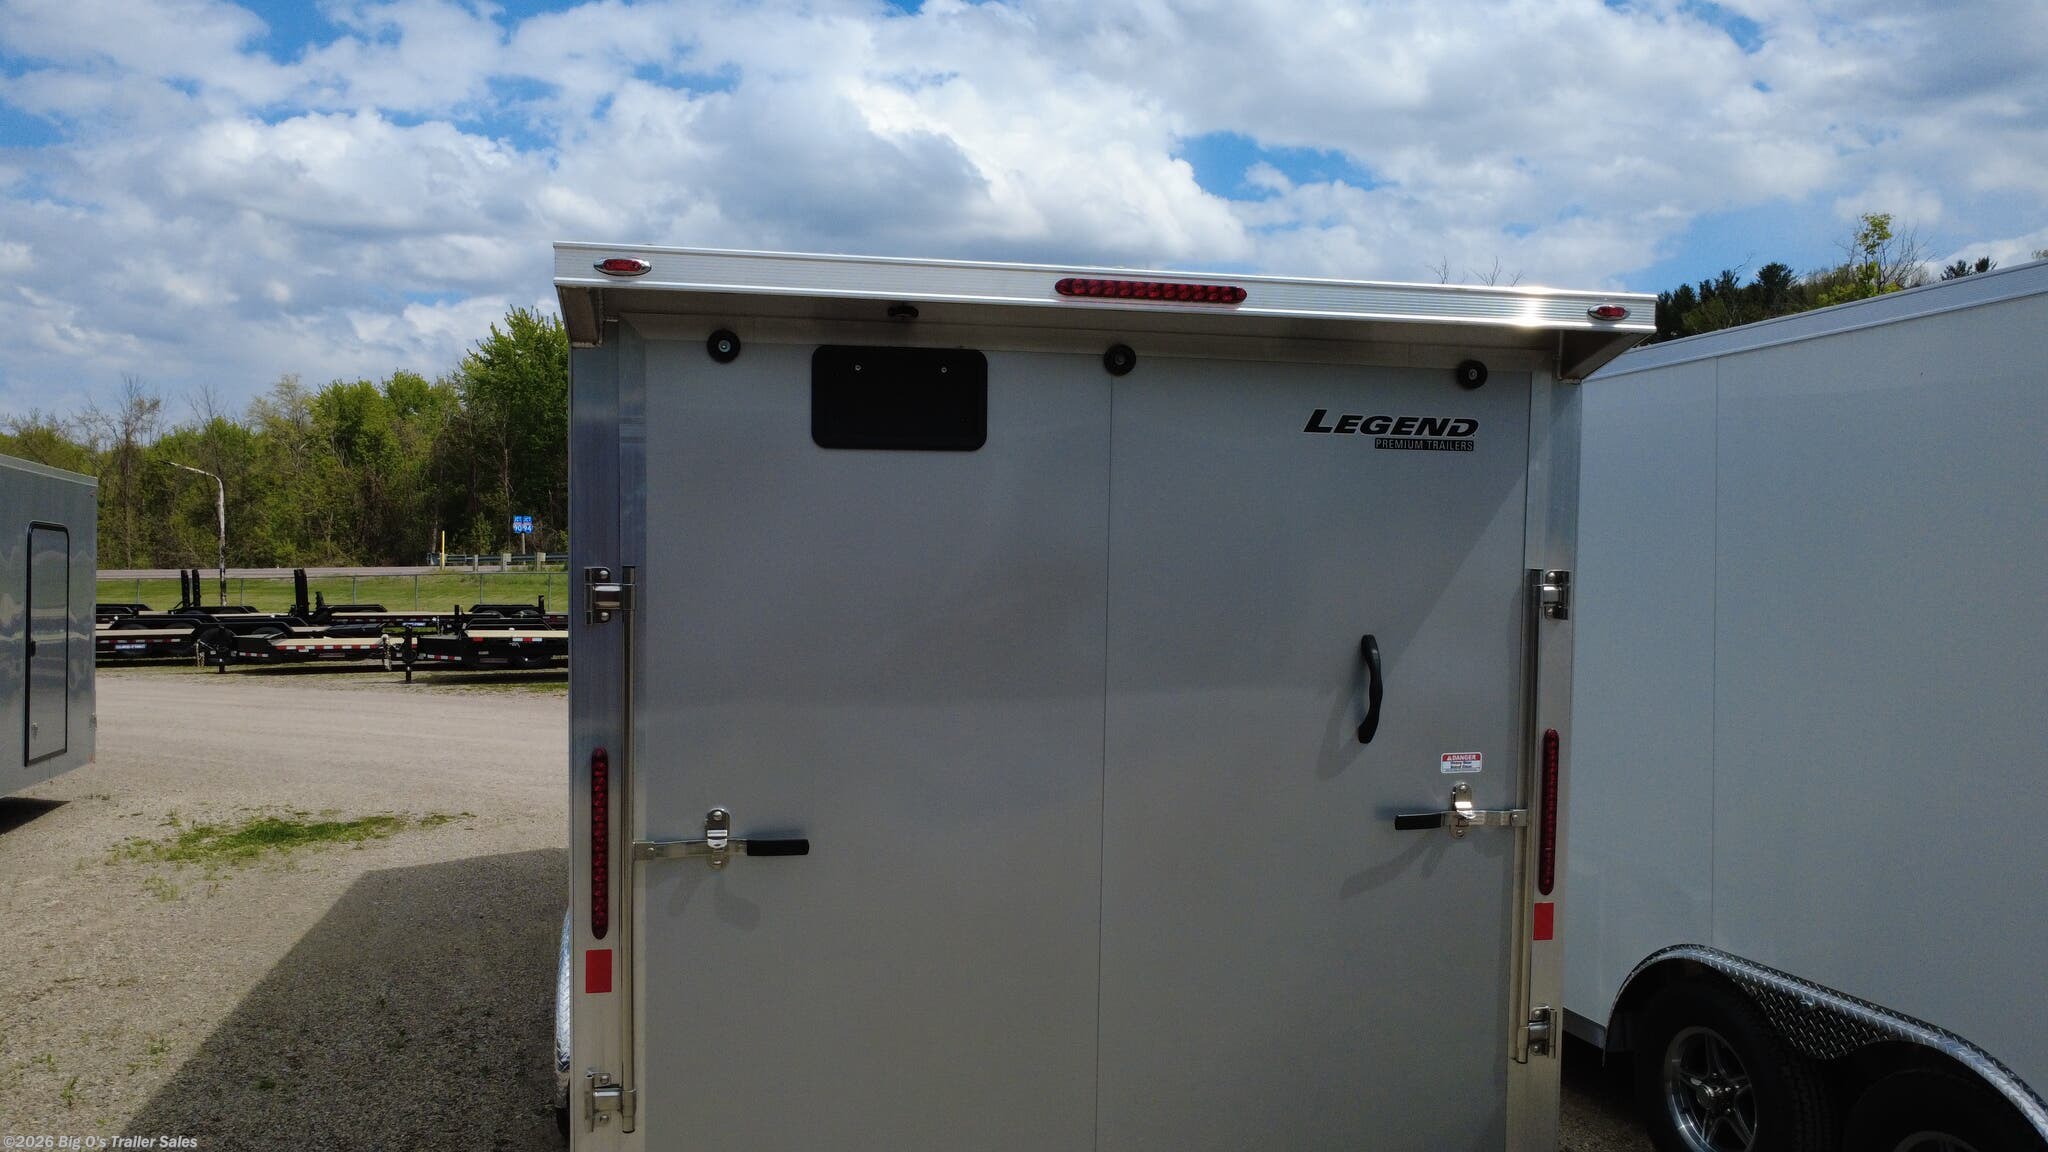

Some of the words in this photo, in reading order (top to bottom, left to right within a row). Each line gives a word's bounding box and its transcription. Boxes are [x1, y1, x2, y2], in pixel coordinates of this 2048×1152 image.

[1303, 408, 1479, 438] LEGEND
[1375, 439, 1423, 450] PREMIUM
[1426, 440, 1473, 451] TRAILERS
